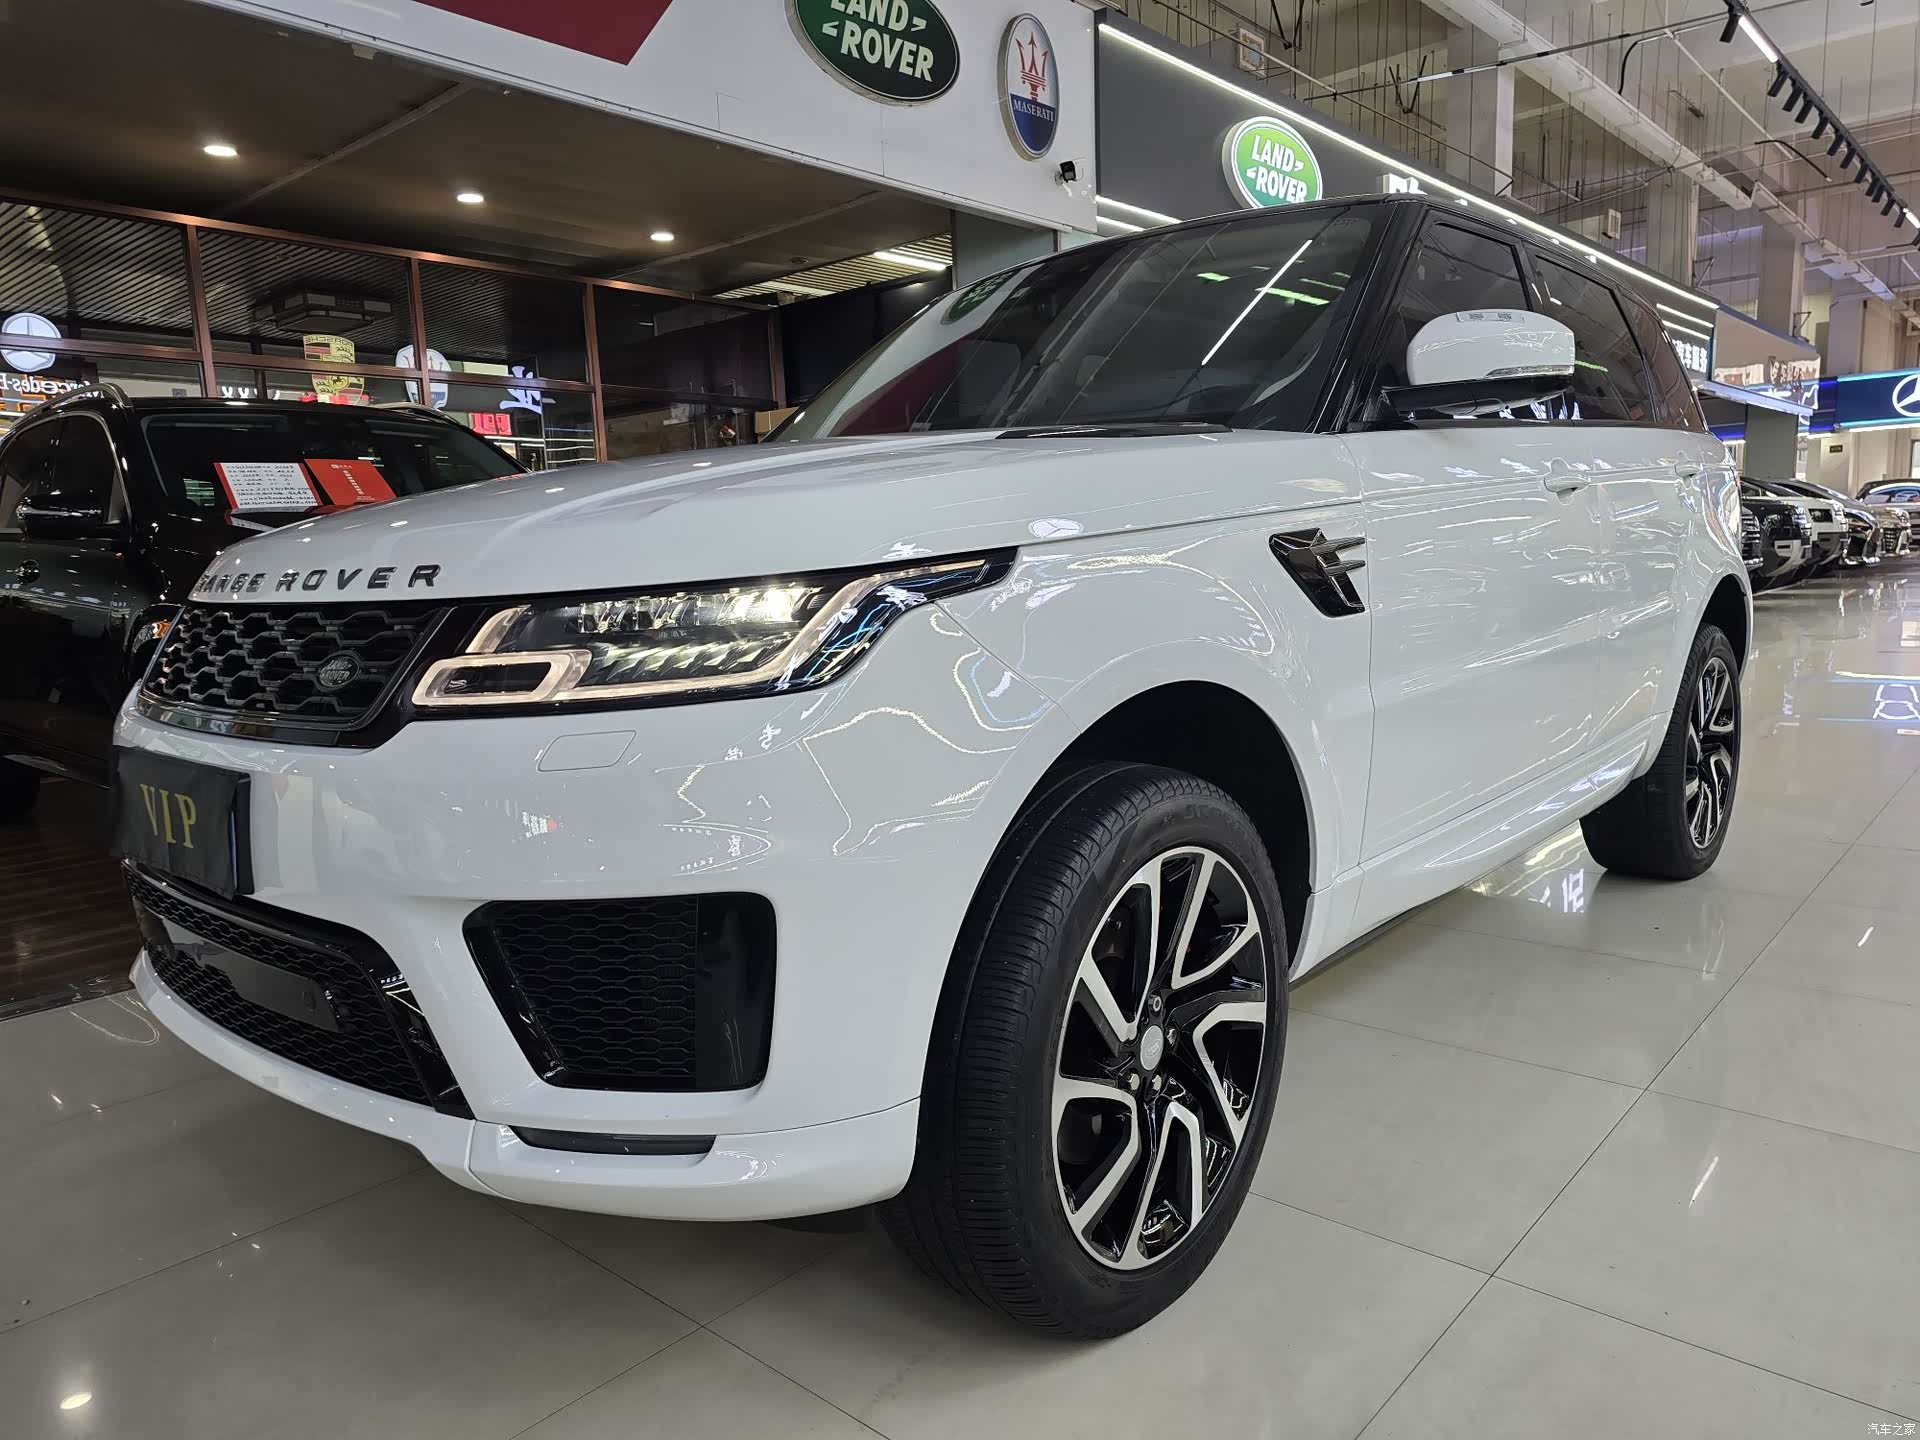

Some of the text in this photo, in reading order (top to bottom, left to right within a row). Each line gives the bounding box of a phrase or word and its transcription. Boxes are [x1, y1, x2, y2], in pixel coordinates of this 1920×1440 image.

[840, 20, 933, 82] ROVER
[1013, 99, 1054, 122] MASERATI
[1251, 134, 1294, 173] LAND
[1255, 166, 1307, 203] ROVER
[275, 564, 441, 592] ROVER
[324, 670, 350, 681] ROVER
[327, 660, 349, 670] LAND
[140, 783, 197, 848] VIP
